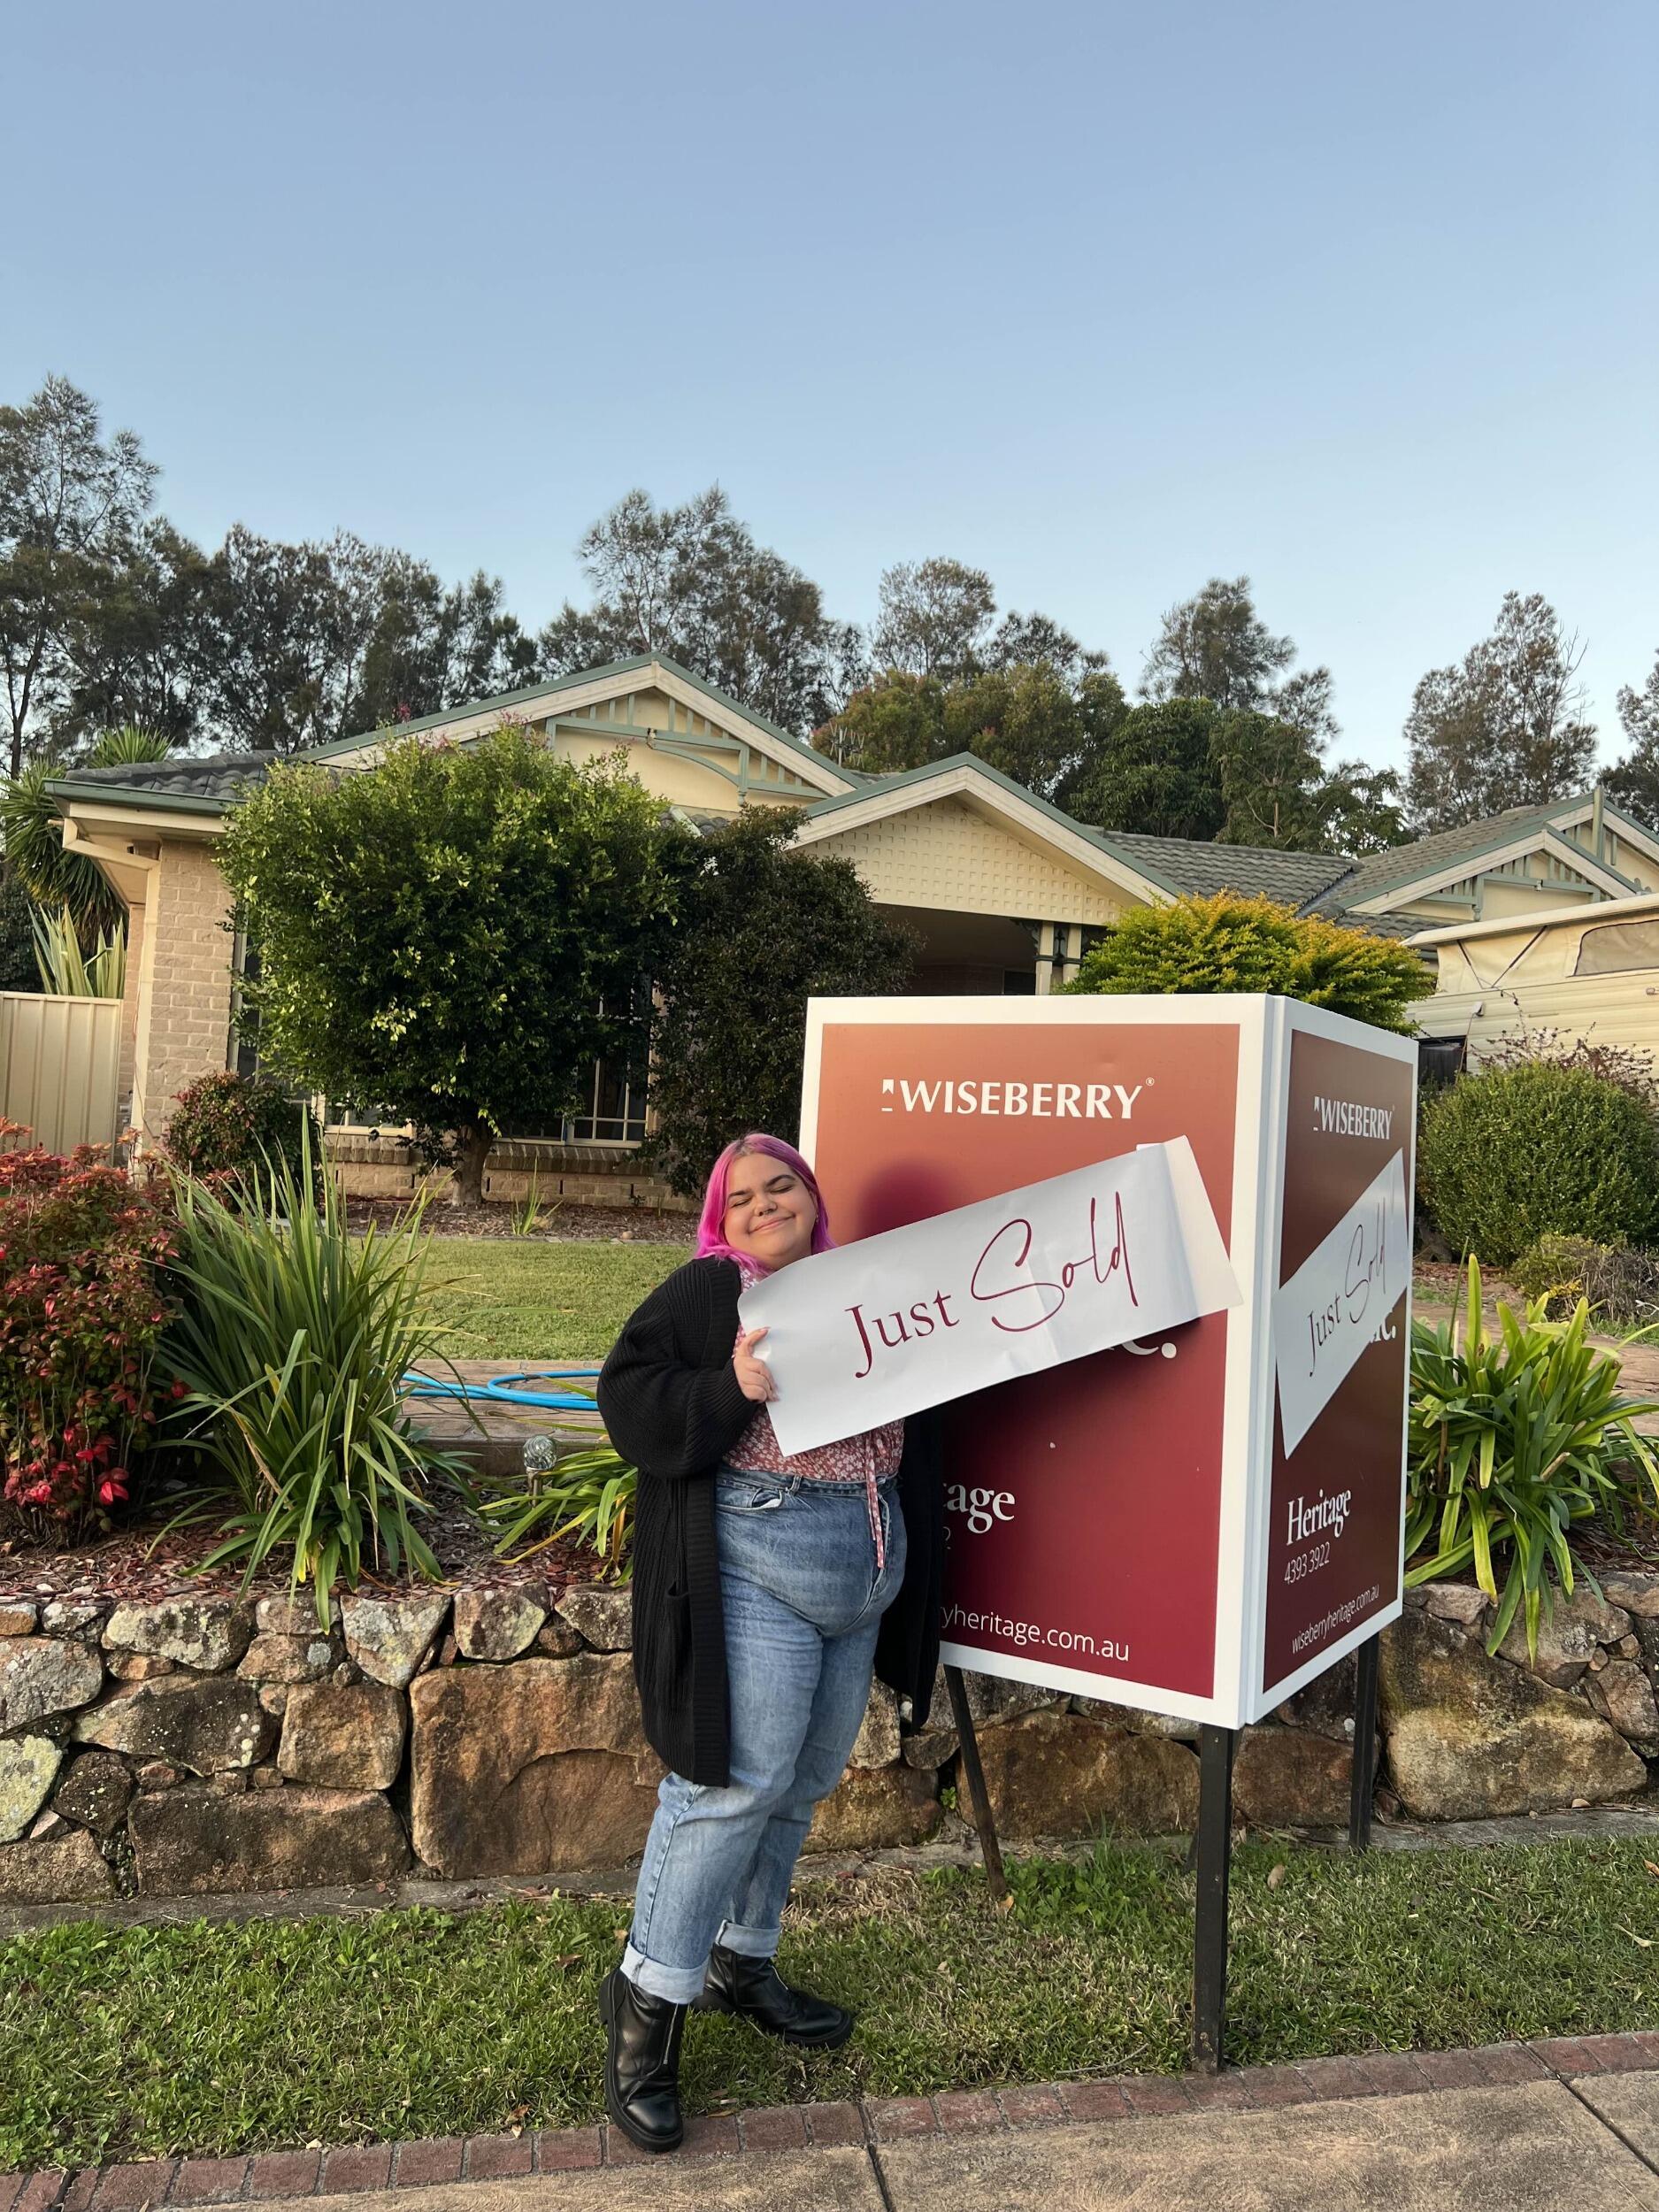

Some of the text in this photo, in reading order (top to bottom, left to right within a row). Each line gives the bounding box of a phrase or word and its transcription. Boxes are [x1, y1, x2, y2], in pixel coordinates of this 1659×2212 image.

[844, 1191, 1139, 1378] Just Sold
[1306, 1292, 1341, 1378] Just
[942, 1482, 1016, 1534] age
[1286, 1488, 1351, 1545] Heritage
[1284, 1541, 1330, 1585] 4393 3922
[941, 1603, 1130, 1662] yheritage.com.au
[1292, 1584, 1379, 1654] wiseberryheritage.com.au
